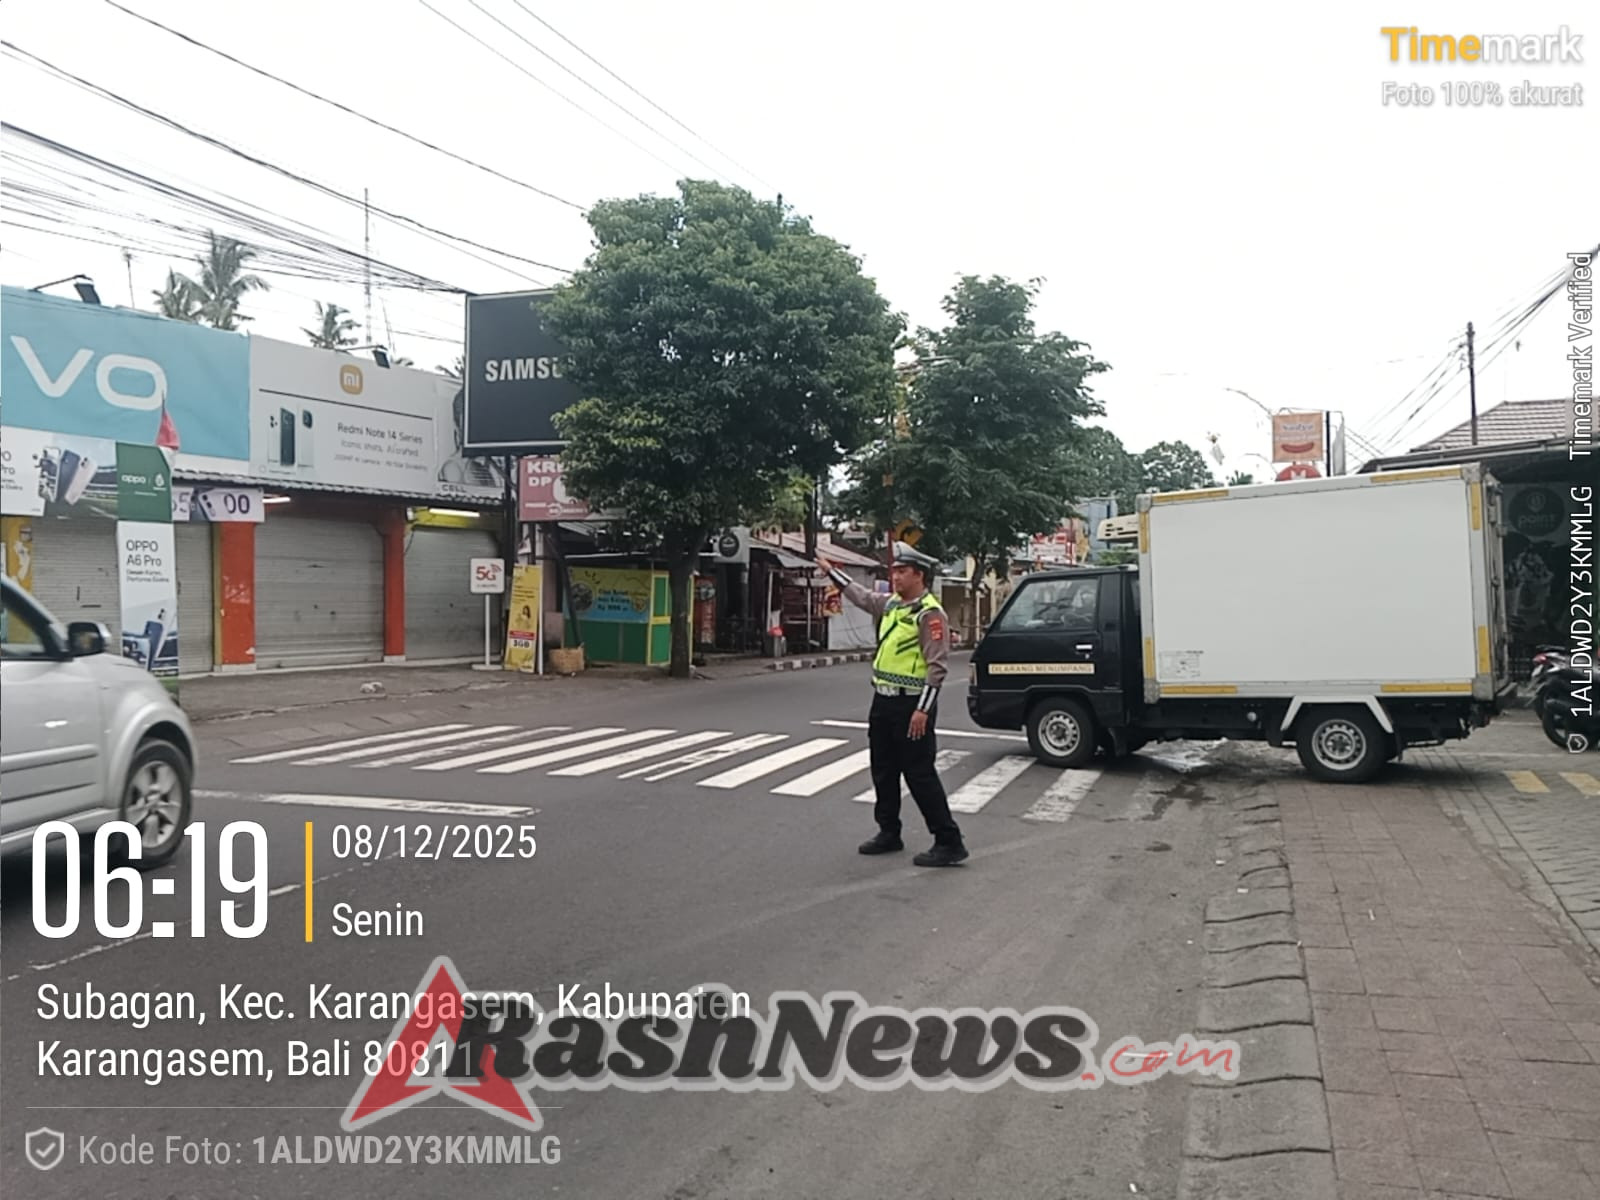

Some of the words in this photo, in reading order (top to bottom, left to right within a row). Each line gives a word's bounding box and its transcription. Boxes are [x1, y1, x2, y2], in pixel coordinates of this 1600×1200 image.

[485, 356, 563, 382] SAMS
[336, 422, 363, 435] Redmi
[365, 427, 385, 439] Note
[387, 430, 398, 440] 14
[399, 432, 423, 445] Series
[121, 474, 146, 484] oppo
[528, 476, 552, 487] DP
[442, 484, 467, 494] CELL
[126, 539, 159, 552] OPPO
[126, 554, 142, 566] A6
[144, 554, 162, 567] Pro
[475, 566, 497, 581] 5G
[991, 663, 1034, 673] DILARANG
[1036, 663, 1092, 673] MENUMPANG
